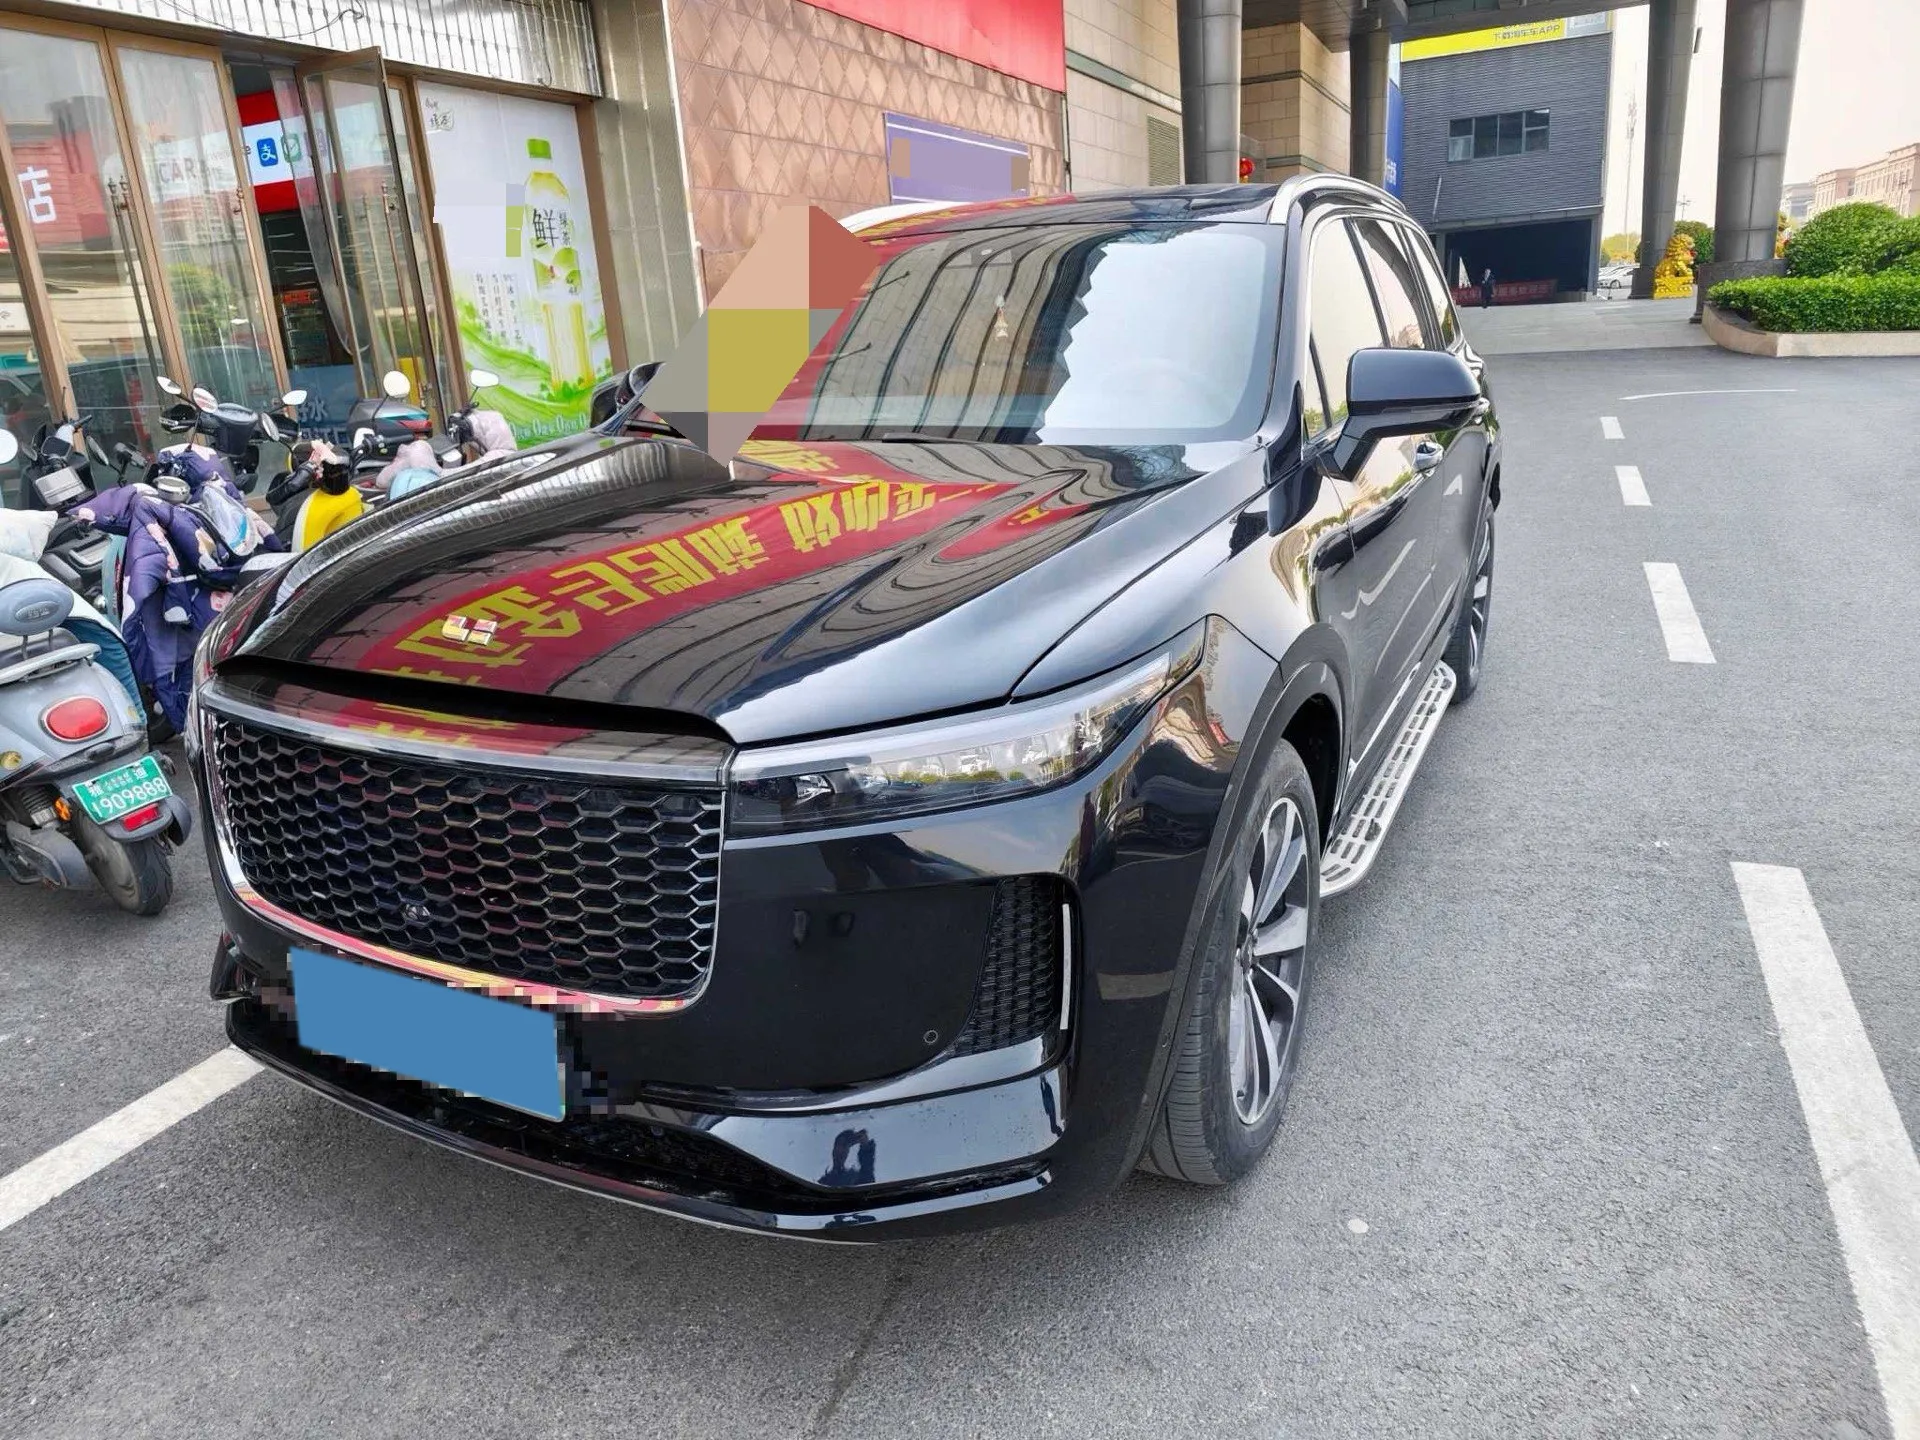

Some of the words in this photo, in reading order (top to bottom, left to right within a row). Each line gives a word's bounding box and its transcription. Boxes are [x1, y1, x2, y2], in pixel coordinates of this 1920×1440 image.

[17, 166, 57, 224] 店
[532, 208, 559, 249] 鲜
[91, 777, 167, 818] 1909888
